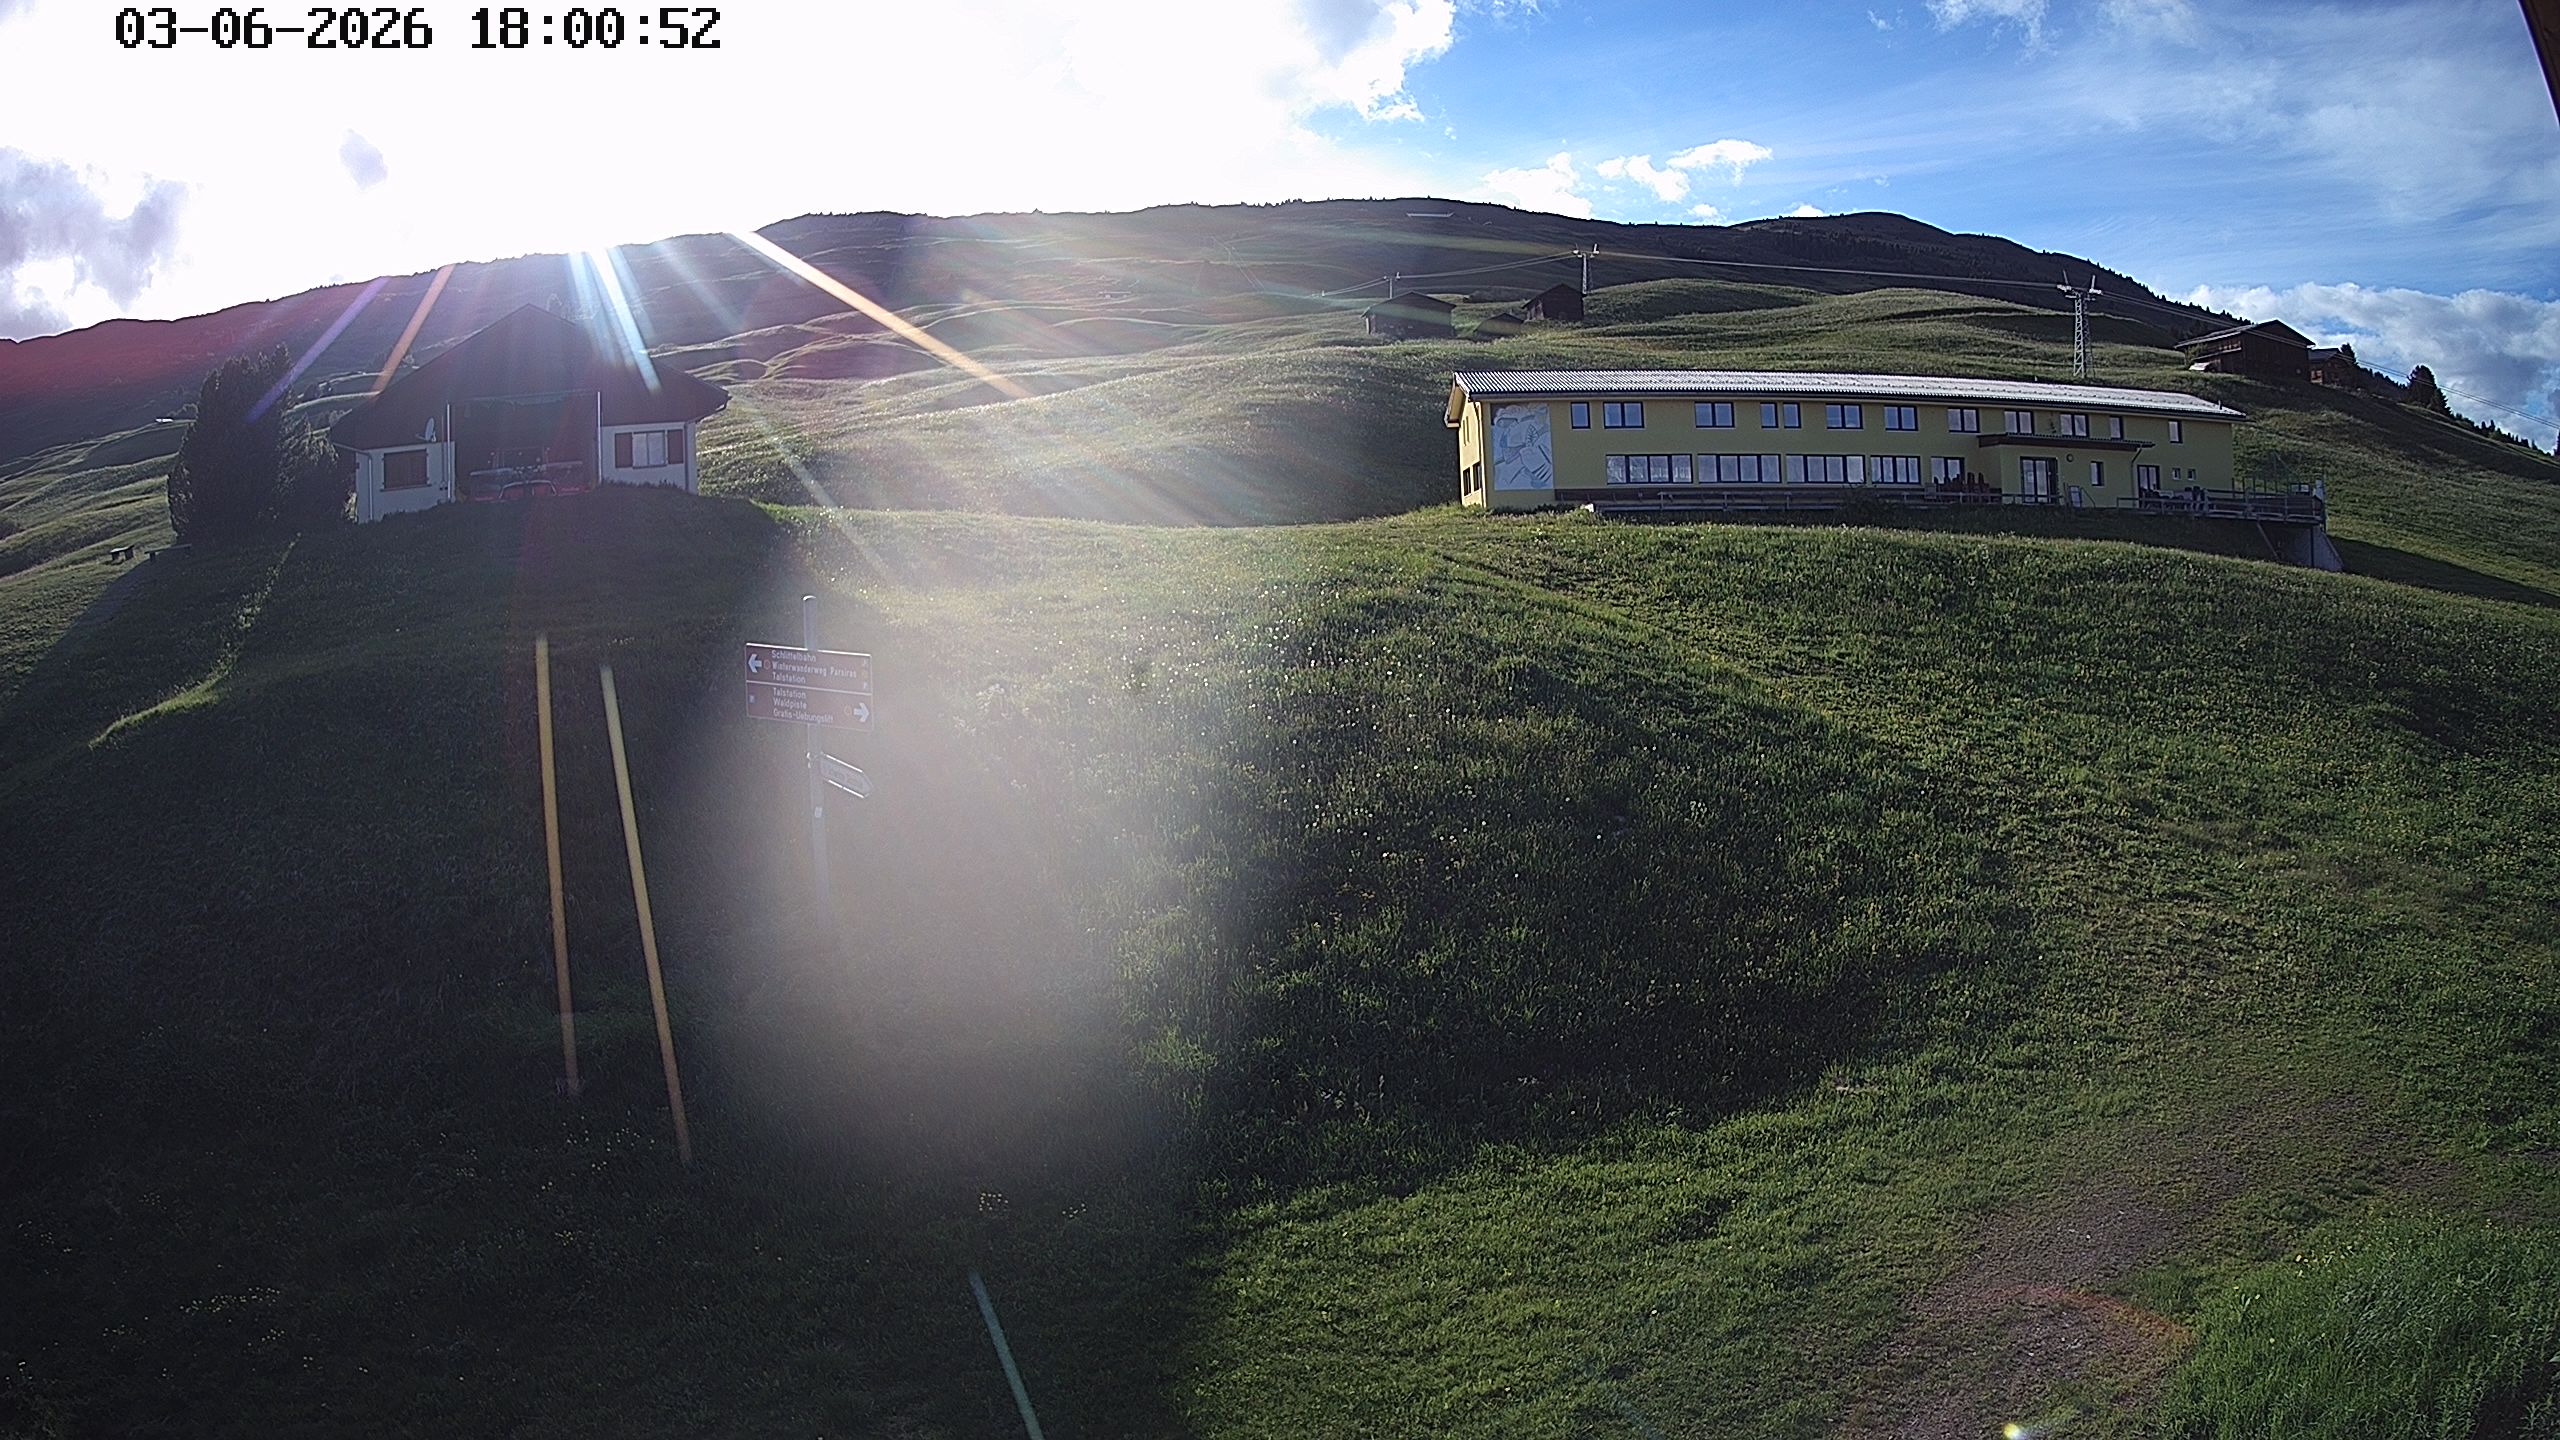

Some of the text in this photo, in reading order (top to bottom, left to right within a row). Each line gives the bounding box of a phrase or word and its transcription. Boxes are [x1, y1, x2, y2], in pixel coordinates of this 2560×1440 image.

[772, 649, 816, 662] Schlittelbahn
[772, 661, 827, 677] Winterwanderweg
[772, 672, 806, 684] Talstation
[773, 687, 806, 699] Talstation
[773, 698, 807, 710] Waldpiste
